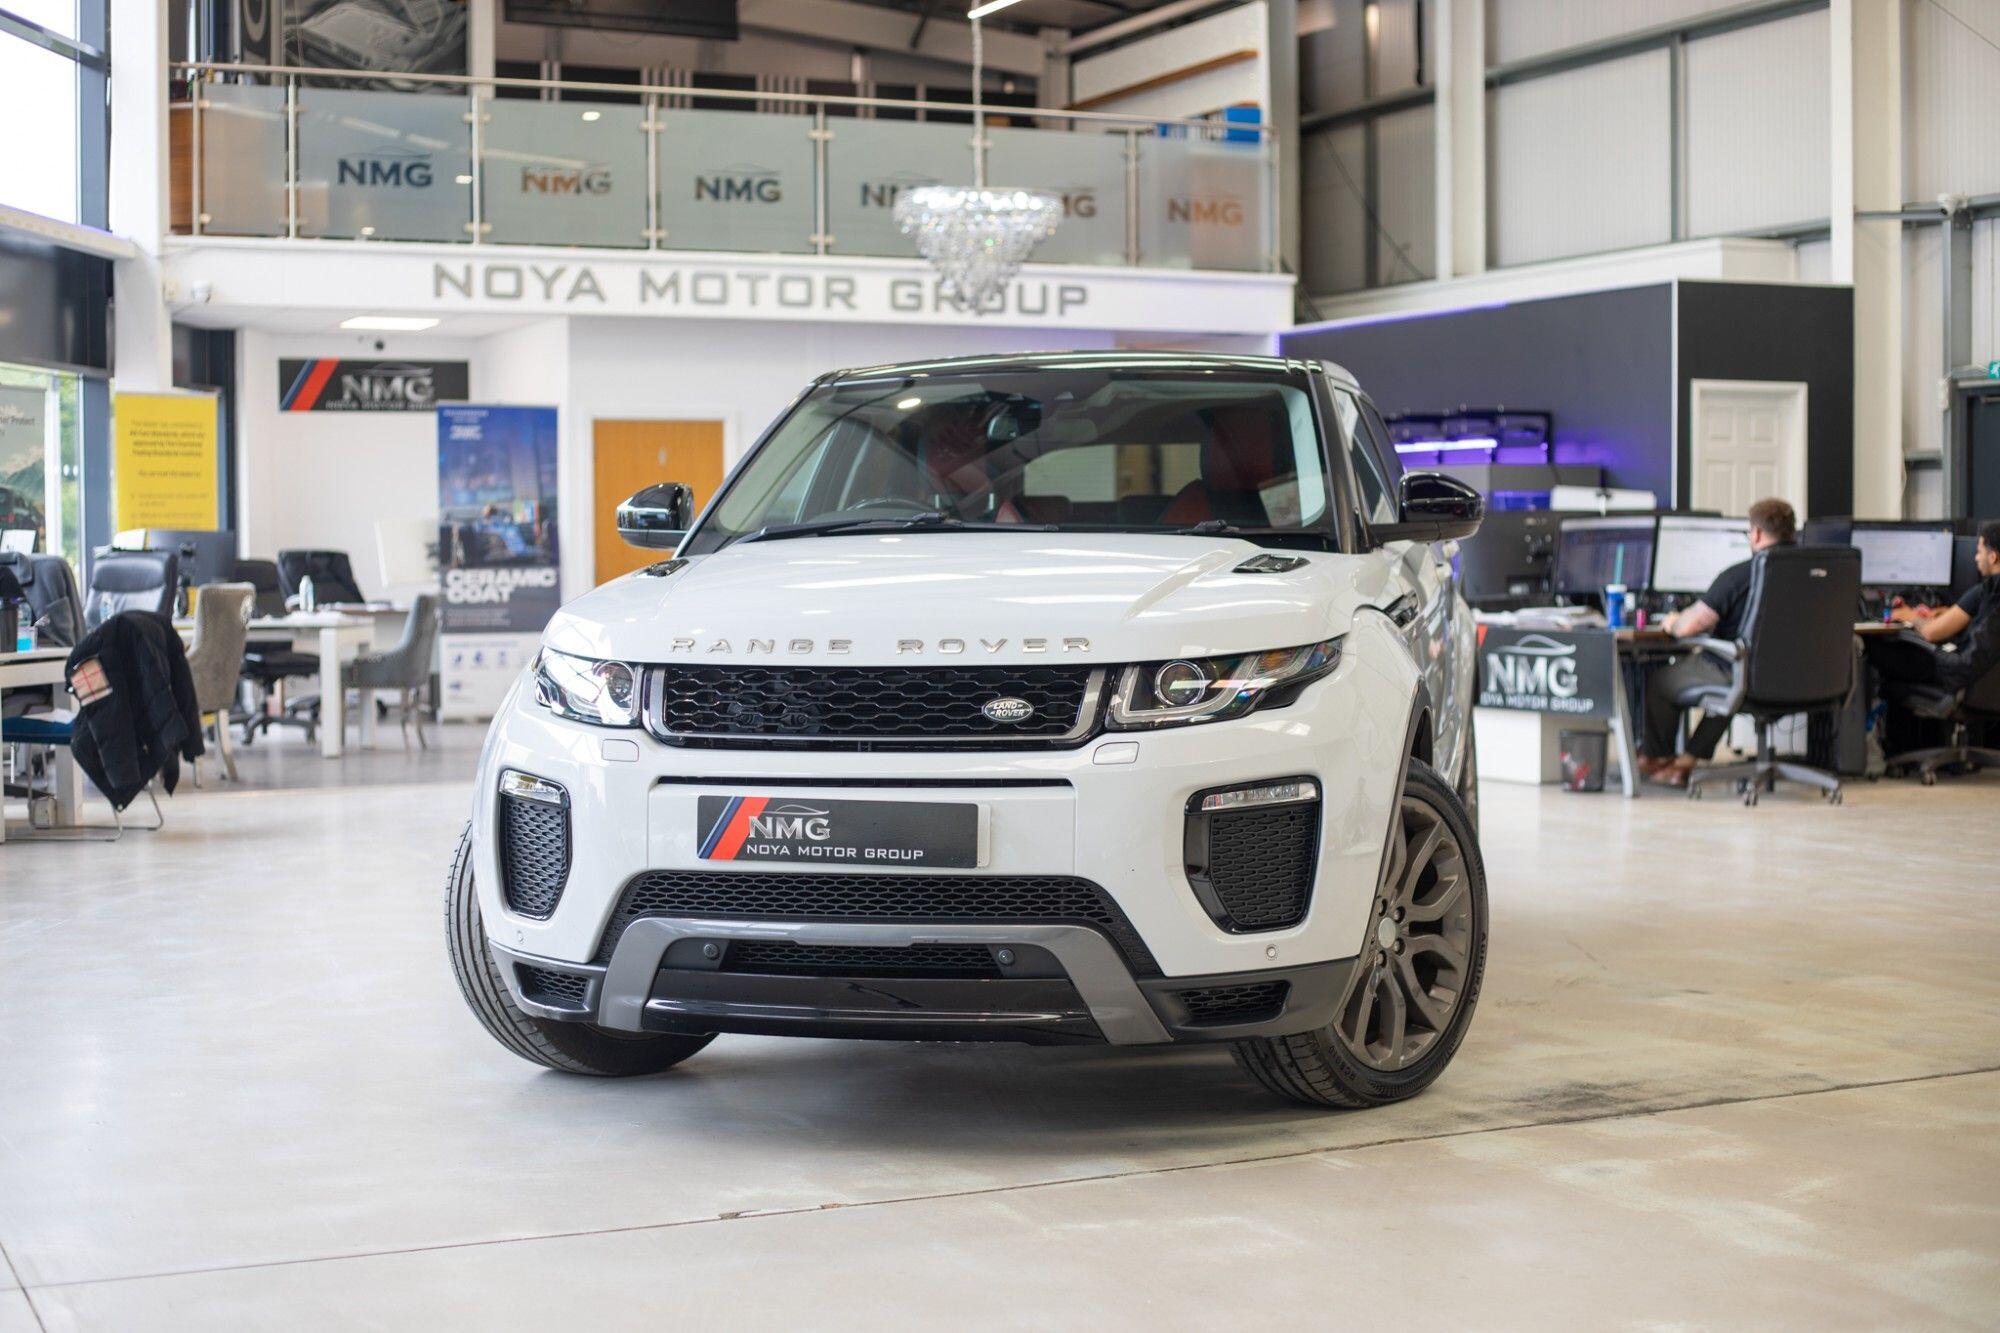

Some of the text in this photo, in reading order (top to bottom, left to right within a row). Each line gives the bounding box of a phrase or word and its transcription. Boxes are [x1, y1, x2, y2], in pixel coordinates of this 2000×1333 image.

[336, 158, 433, 187] NMG
[520, 168, 612, 194] NMG
[694, 176, 783, 204] NMG
[1167, 197, 1244, 227] NMG
[432, 263, 606, 302] NOYA
[639, 268, 859, 310] MOTOR
[341, 374, 435, 402] NMG
[446, 568, 557, 587] CERAMIC
[446, 584, 513, 604] COAT
[670, 636, 1091, 655] RANGE ROVER
[1486, 652, 1578, 698] NMG
[995, 709, 1024, 717] ROVER
[748, 815, 831, 841] NMG
[746, 844, 924, 860] NOYA MOTOR GROUP
